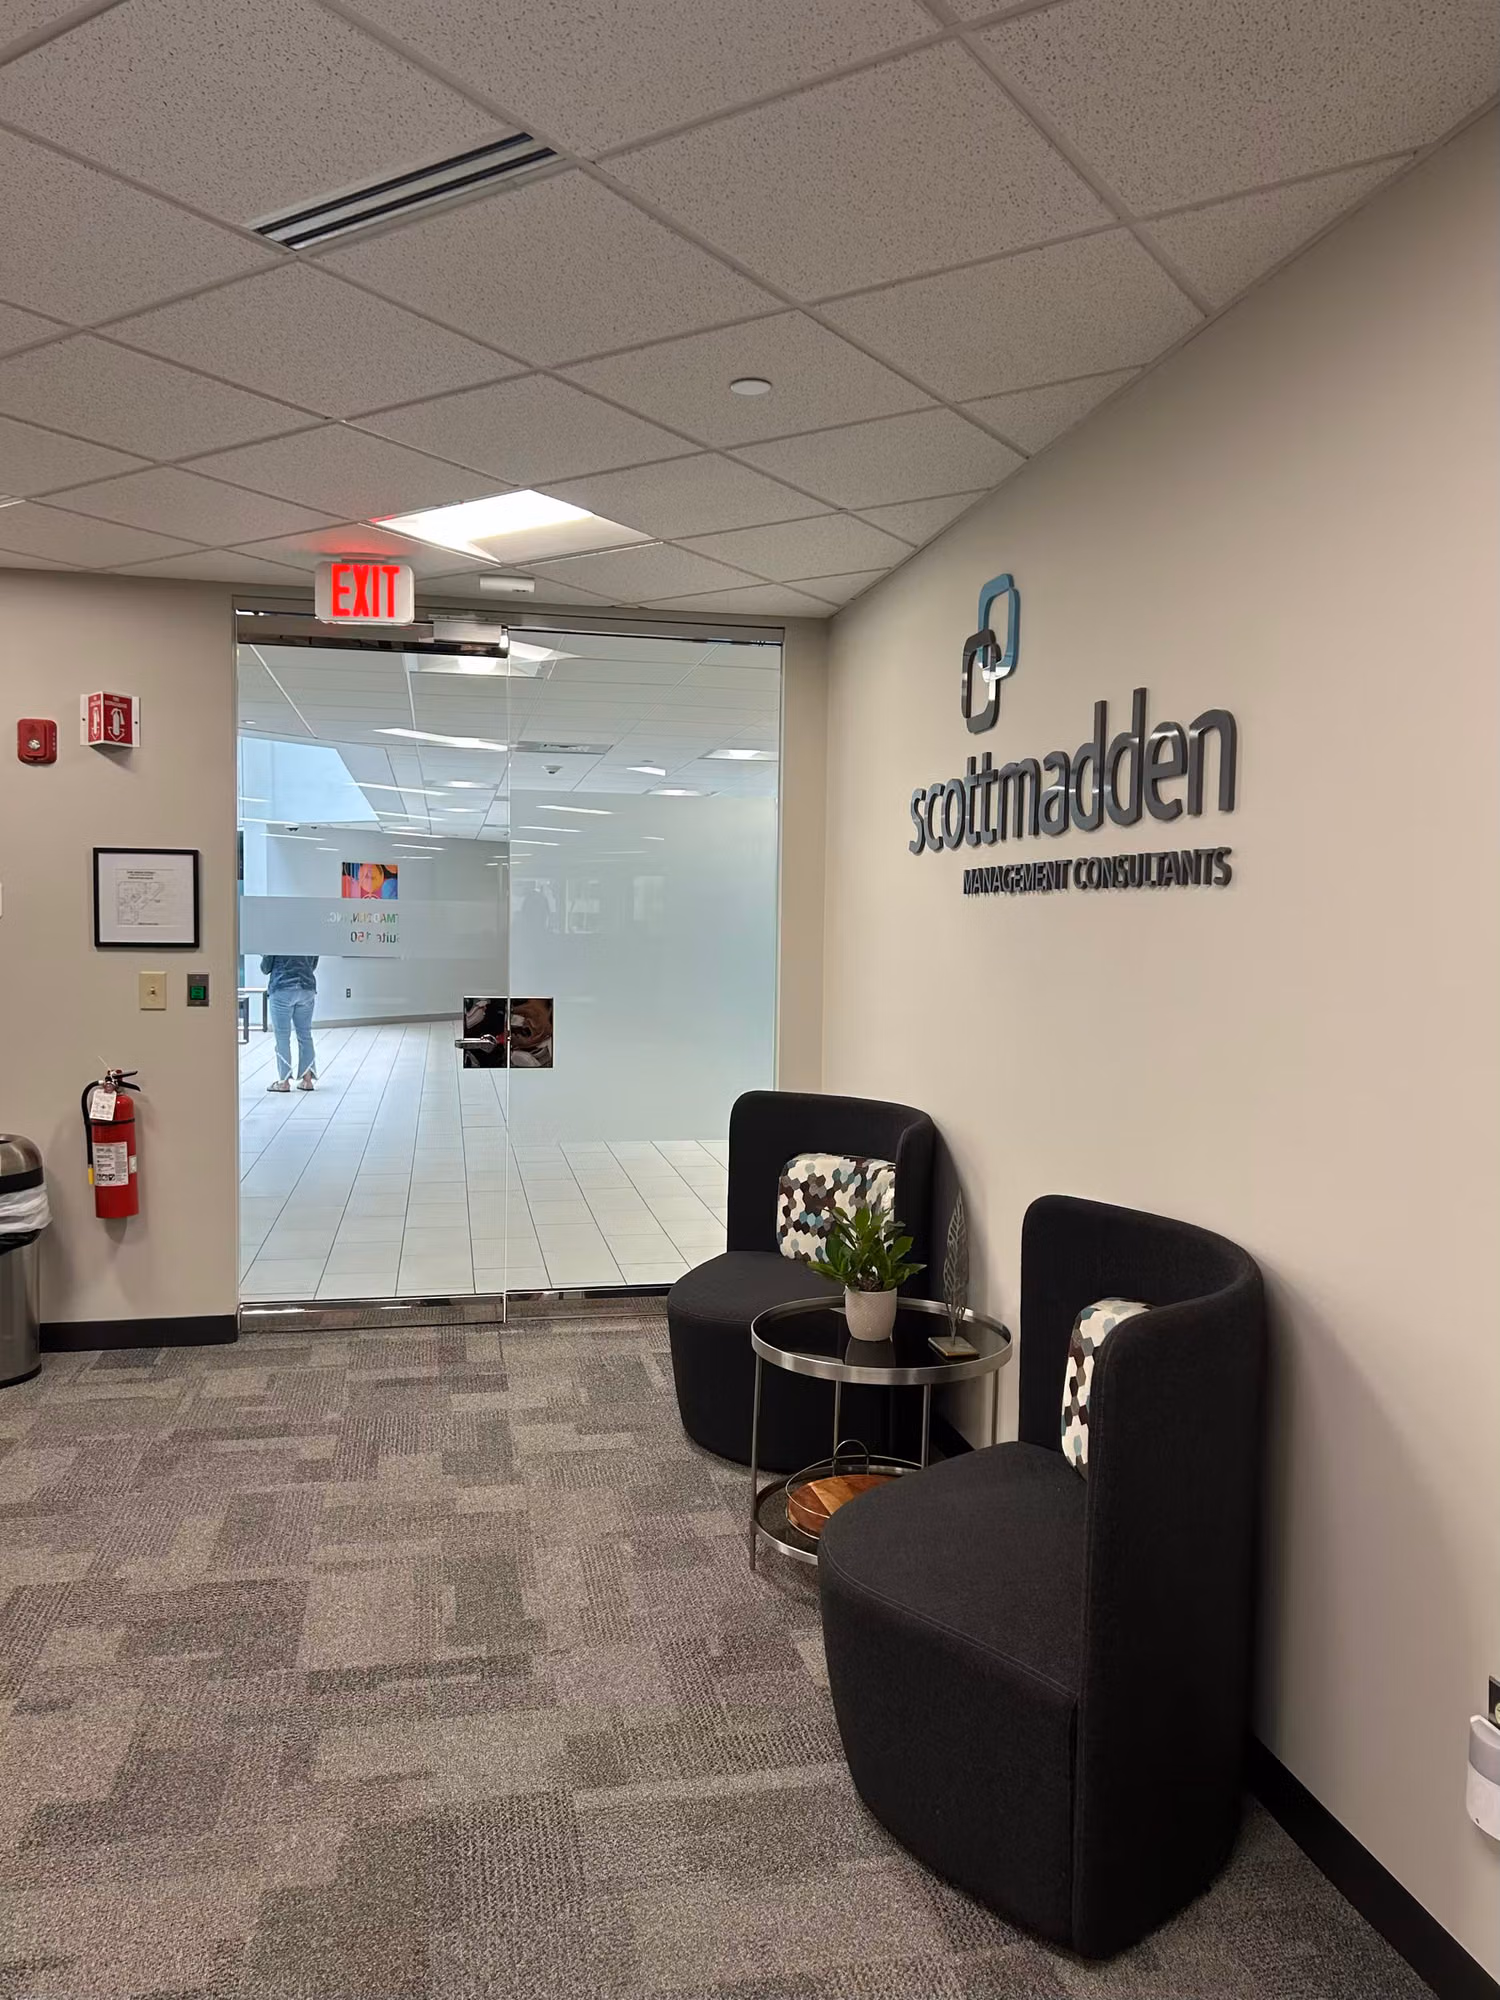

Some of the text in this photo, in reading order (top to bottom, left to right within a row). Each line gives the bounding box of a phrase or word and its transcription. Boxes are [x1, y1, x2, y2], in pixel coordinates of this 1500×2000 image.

[331, 563, 400, 618] EXIT
[910, 688, 1236, 855] scottmadden
[964, 847, 1232, 895] MANAGEMENT CONSULTANTS
